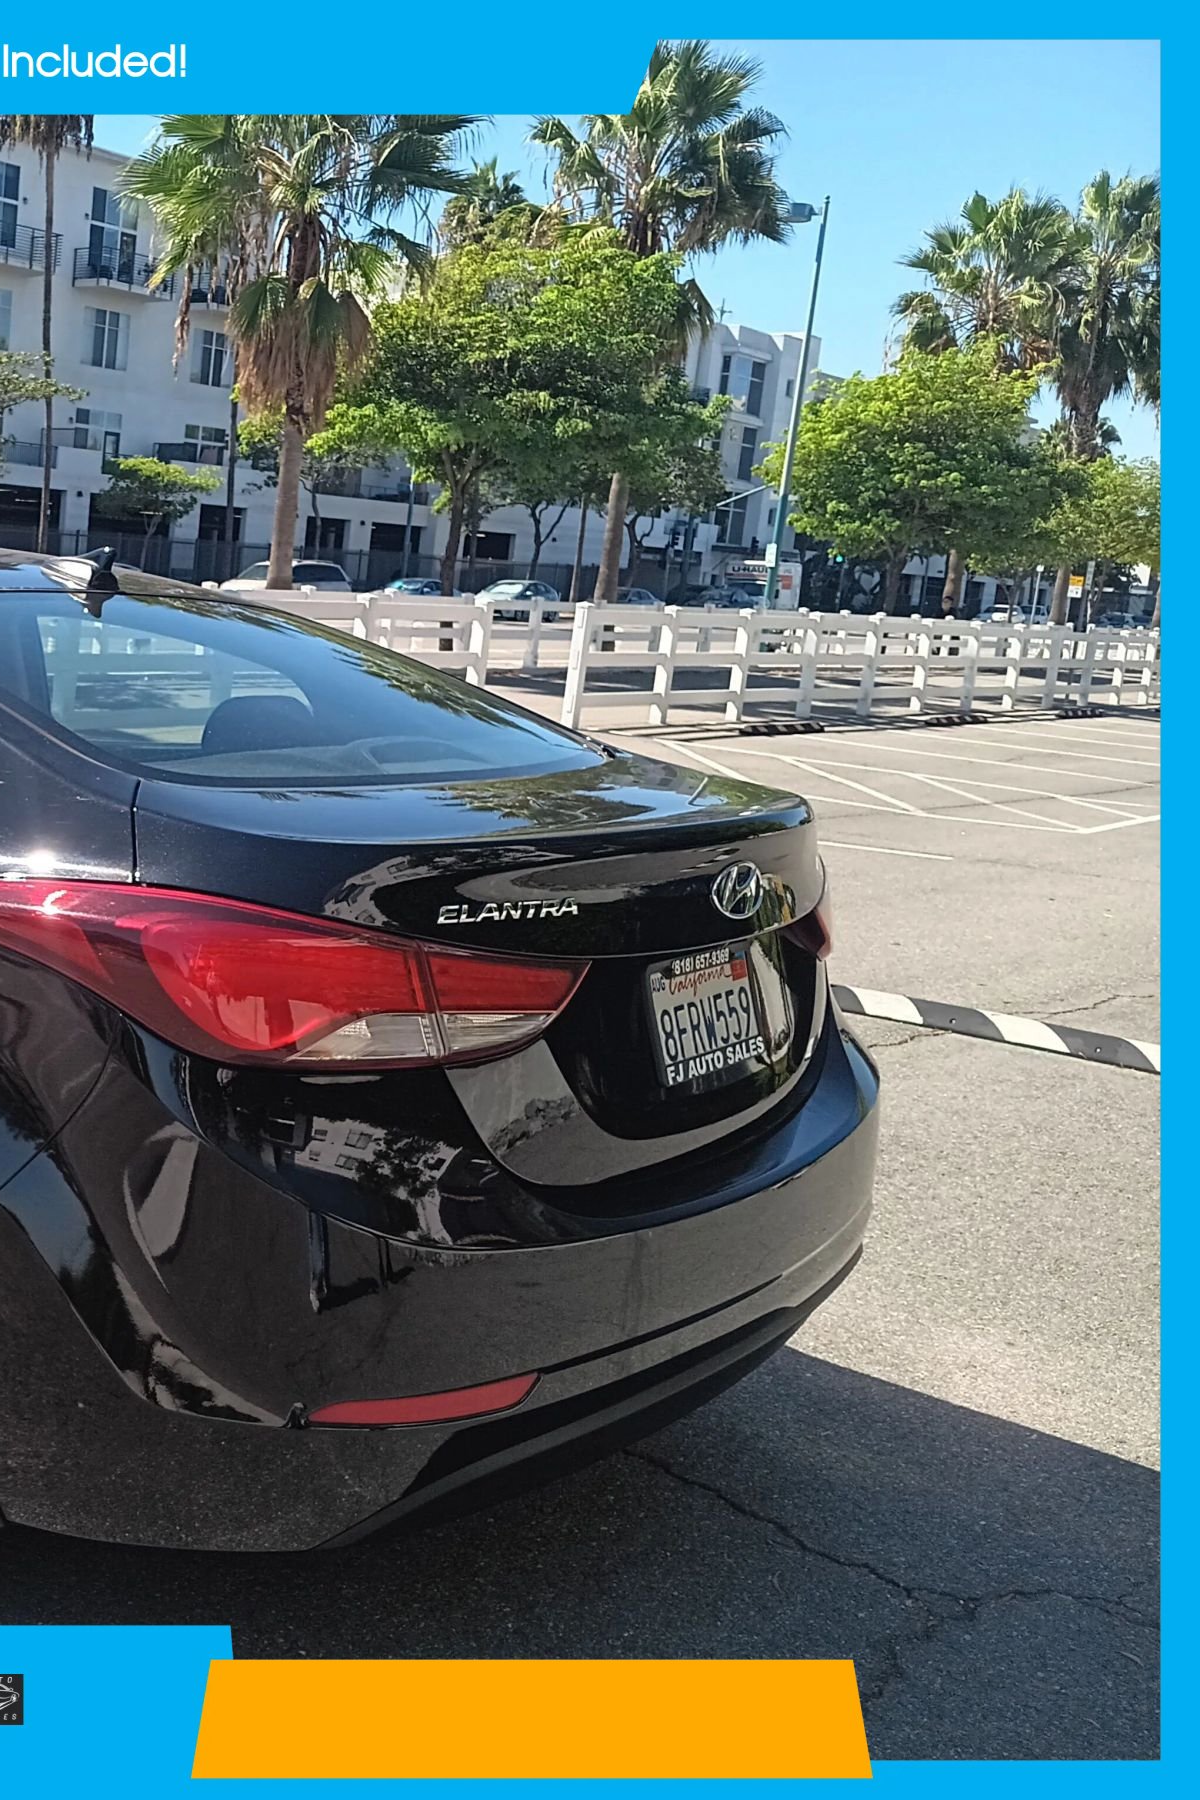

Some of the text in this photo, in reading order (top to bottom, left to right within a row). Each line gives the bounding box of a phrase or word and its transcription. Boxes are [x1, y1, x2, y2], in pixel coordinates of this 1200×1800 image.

[437, 897, 579, 924] ELANTRA
[668, 964, 732, 997] California
[660, 985, 751, 1062] 8FRW559
[666, 1036, 765, 1086] FJ AUTO SALES
